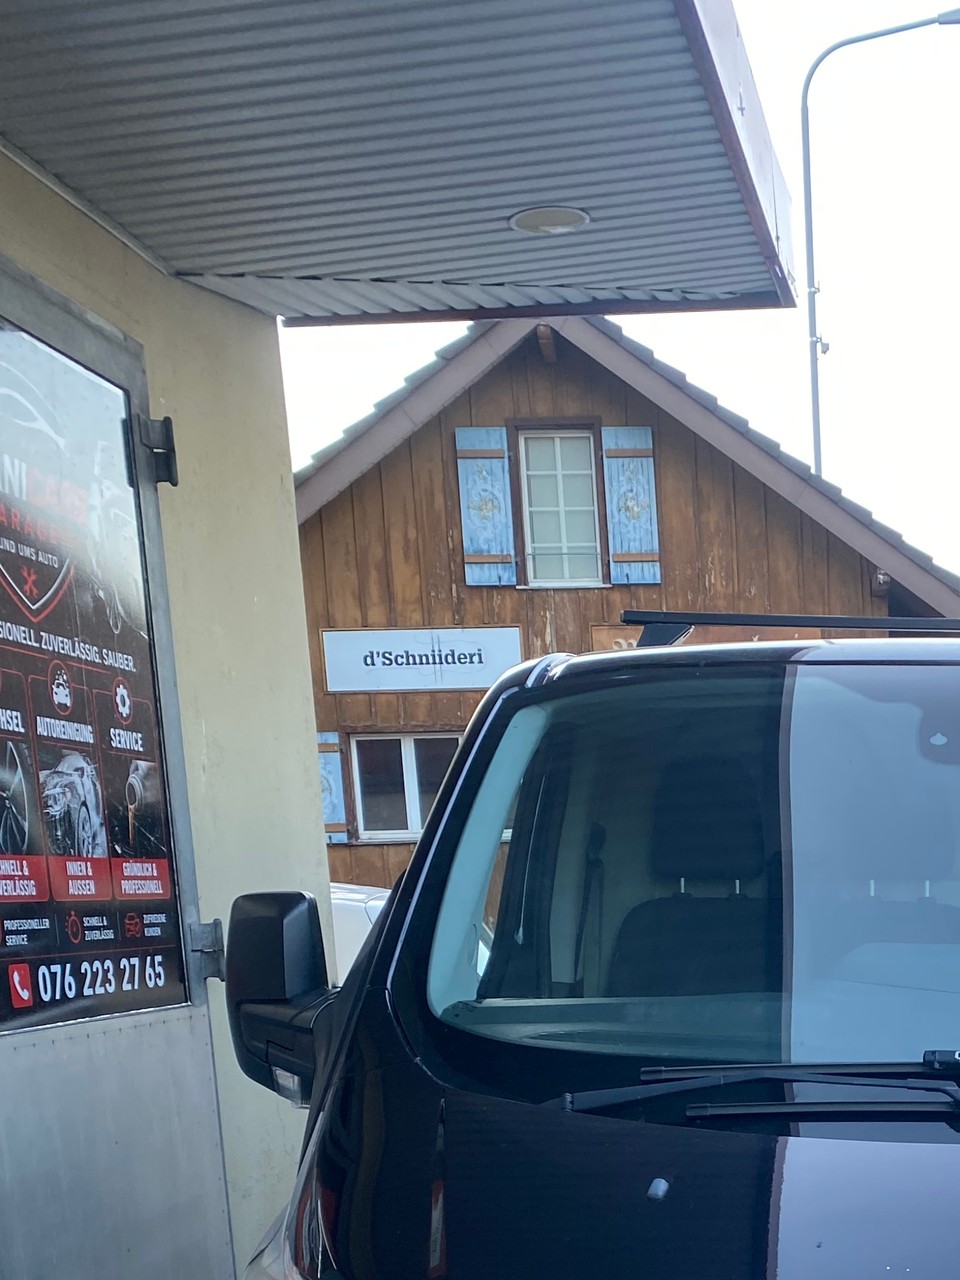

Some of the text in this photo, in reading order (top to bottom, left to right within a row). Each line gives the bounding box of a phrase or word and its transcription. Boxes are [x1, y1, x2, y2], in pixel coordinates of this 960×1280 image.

[17, 543, 36, 560] UMS
[37, 550, 59, 569] AUTO
[40, 630, 102, 663] ZUVERLÄSSIG.
[102, 648, 137, 672] SAUBER.
[36, 715, 95, 744] AUTOREINIGUNG
[109, 728, 144, 751] SERVICE
[0, 860, 22, 876] HNELL
[66, 861, 93, 876] INNEN &
[122, 860, 152, 876] GRÜNDLICH
[69, 879, 95, 895] AUSSEN
[121, 880, 163, 894] PROFESSIONELL
[4, 918, 50, 931] PROFESSIONELLER
[83, 916, 103, 927] SCHNELL
[6, 934, 29, 946] SERVICE
[85, 928, 115, 941] ZUVERLÄSSIG
[38, 954, 165, 1002] 076 223 27 65
